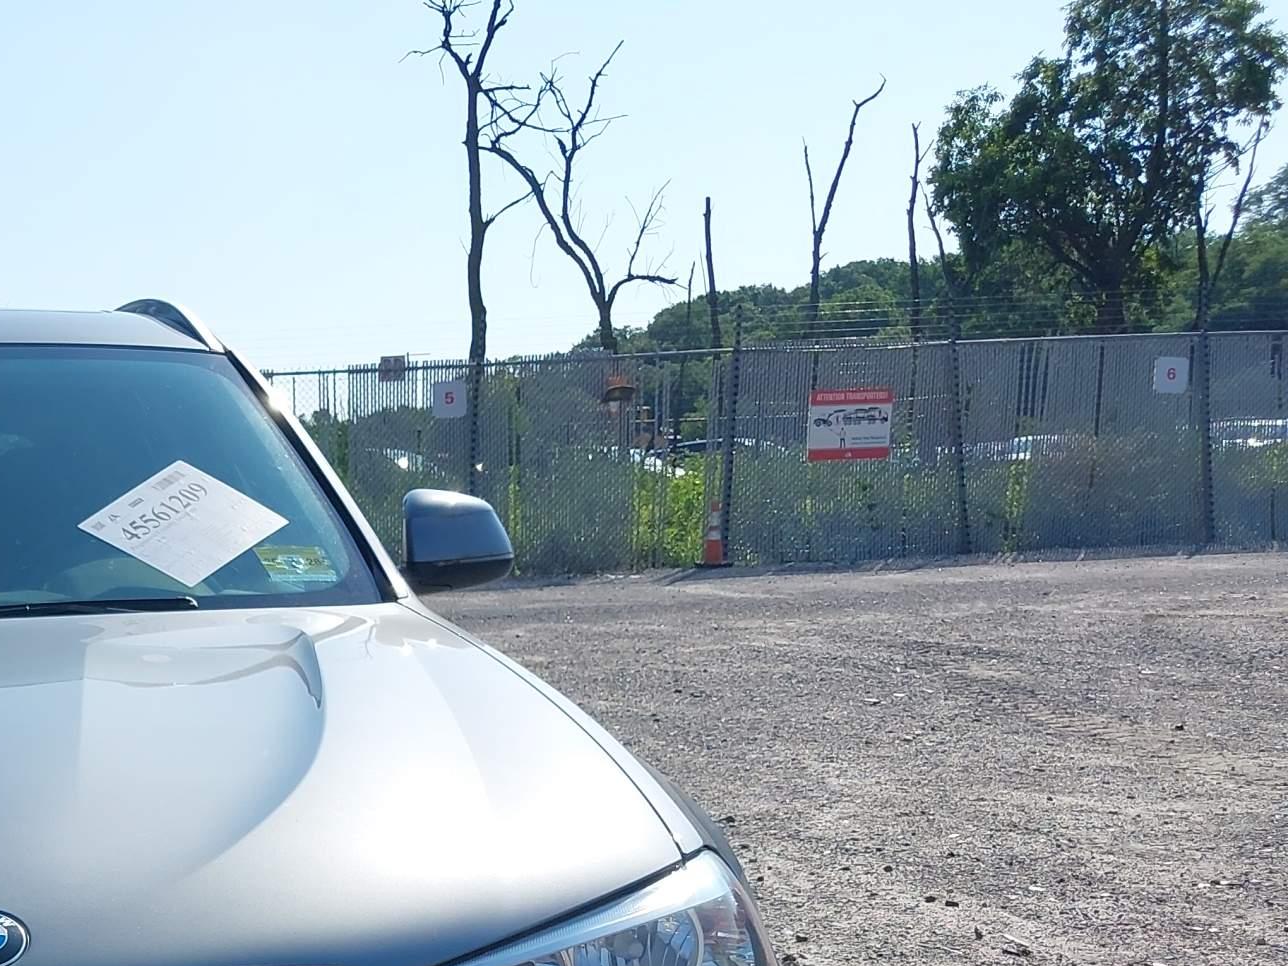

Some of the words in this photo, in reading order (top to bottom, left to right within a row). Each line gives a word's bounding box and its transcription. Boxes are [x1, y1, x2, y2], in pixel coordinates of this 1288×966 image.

[1167, 367, 1176, 381] 6
[443, 391, 455, 405] 5
[816, 392, 845, 401] ATTENTION
[121, 482, 208, 541] 45561209
